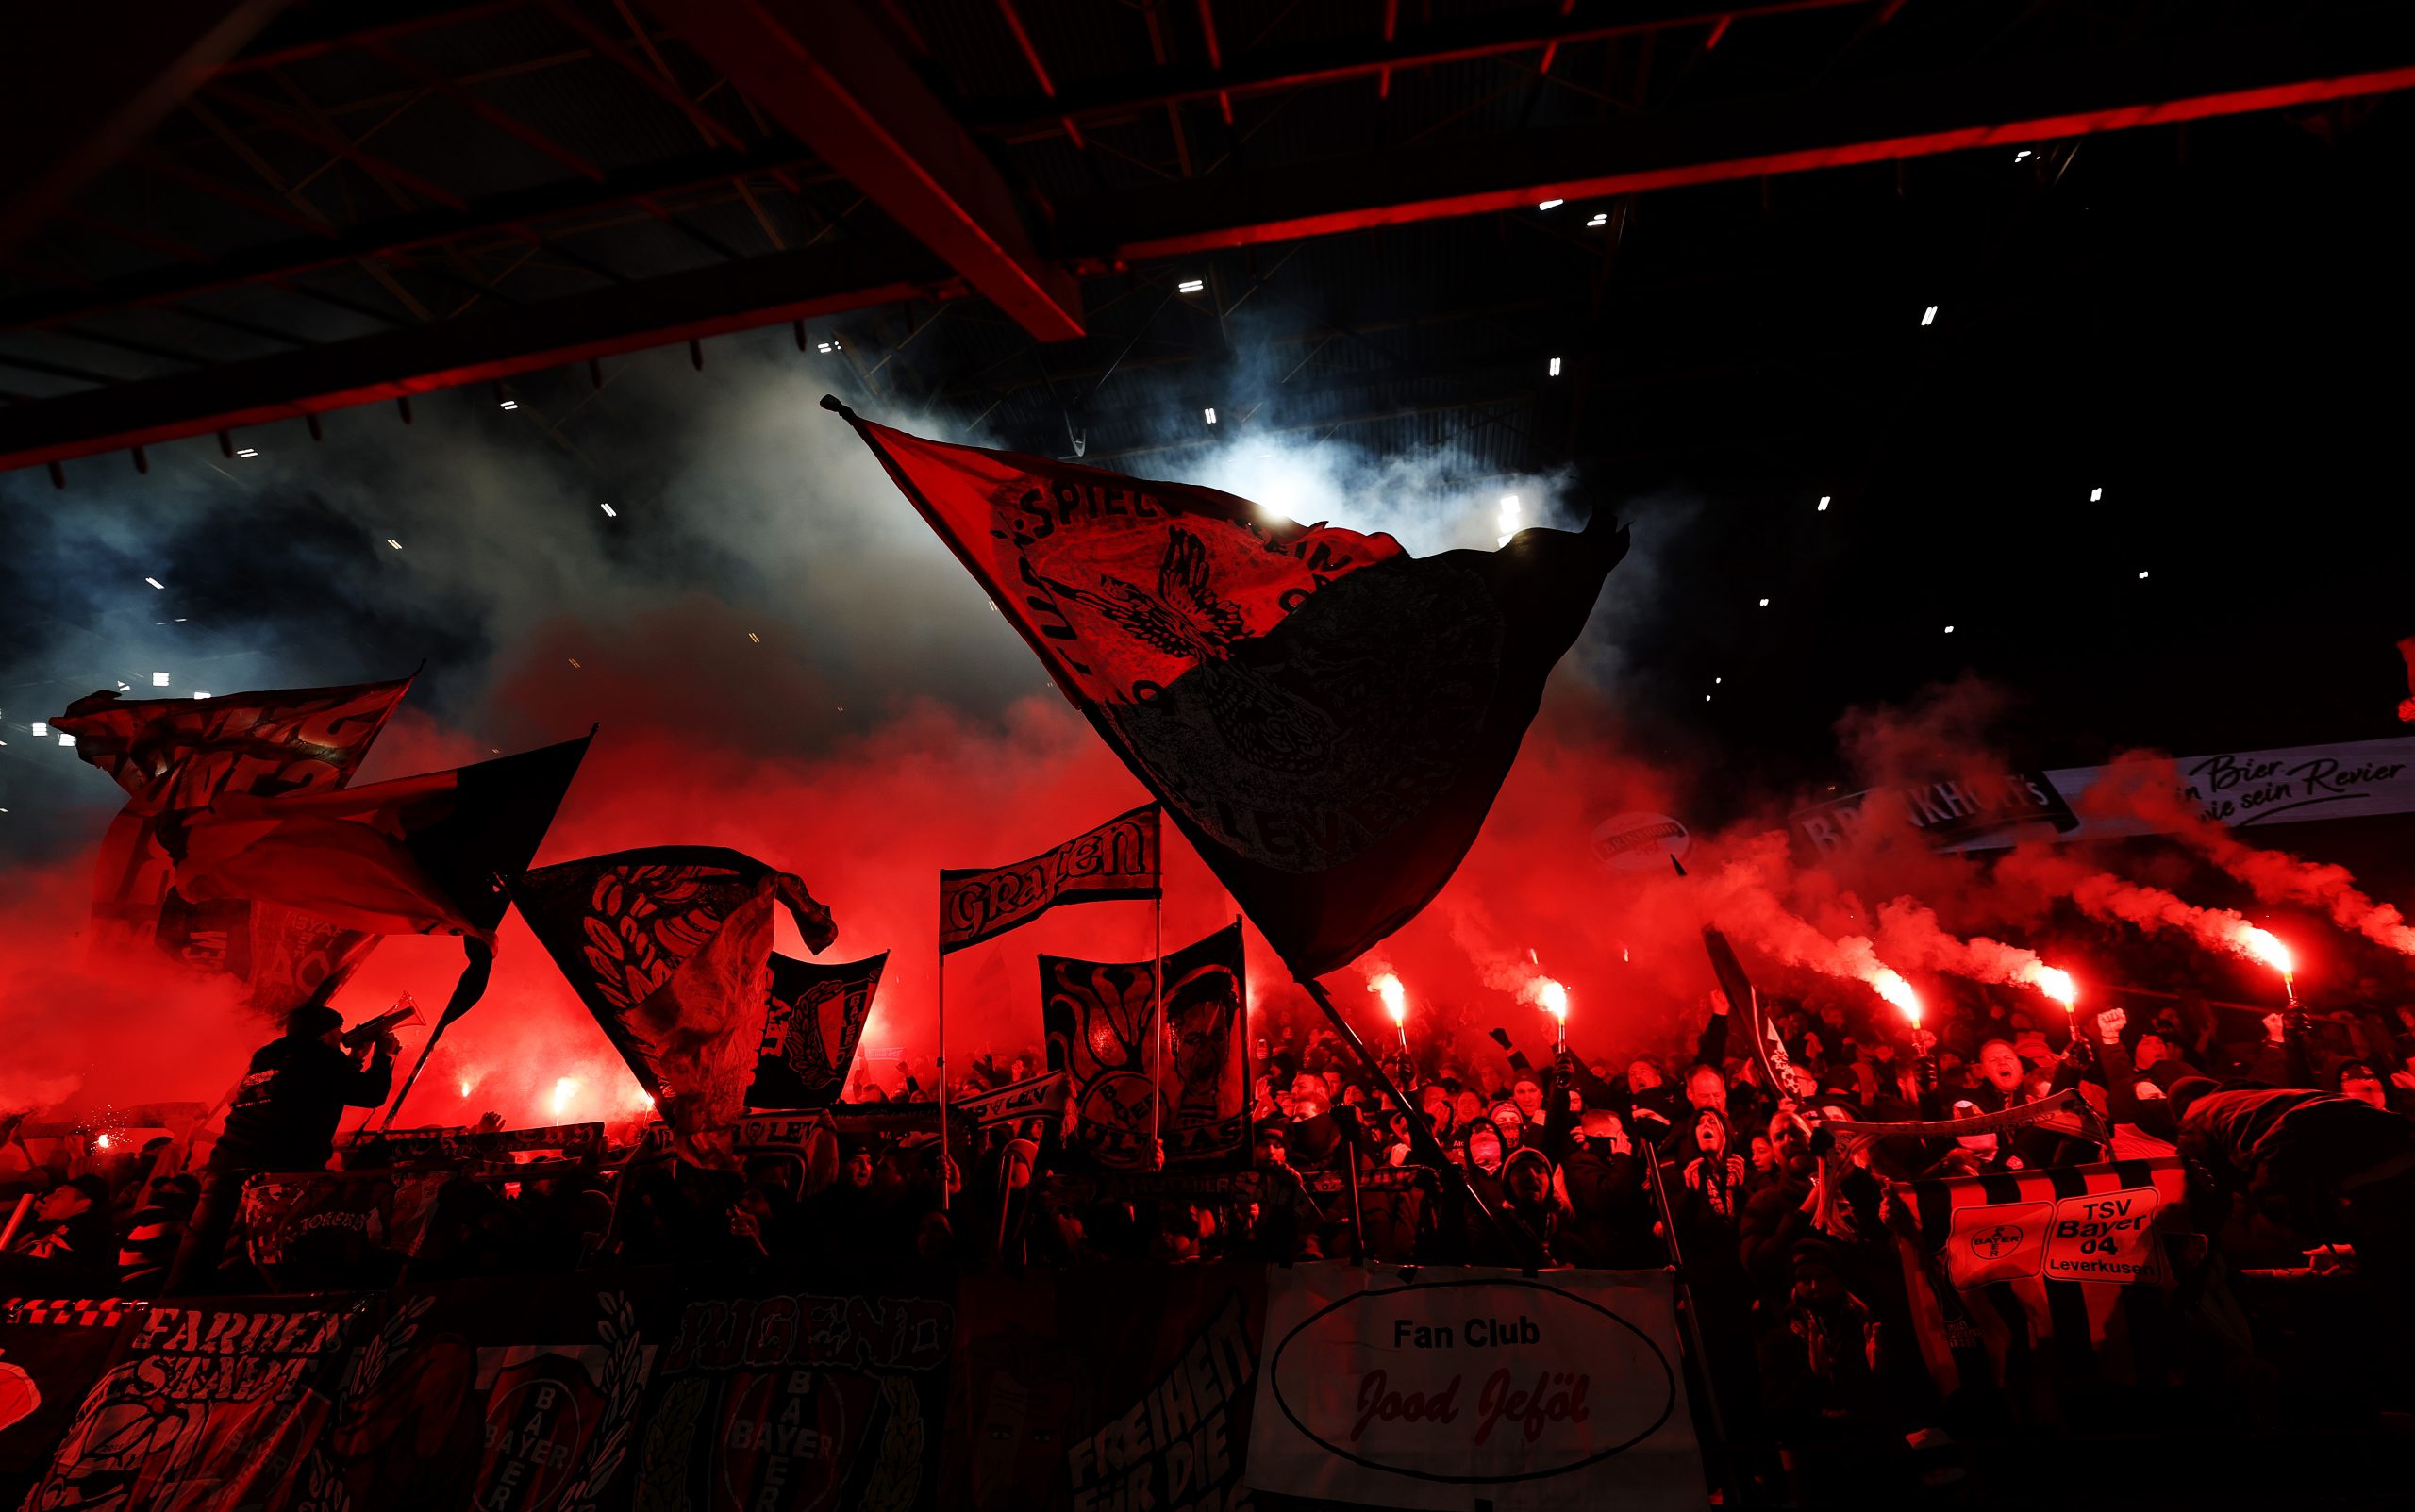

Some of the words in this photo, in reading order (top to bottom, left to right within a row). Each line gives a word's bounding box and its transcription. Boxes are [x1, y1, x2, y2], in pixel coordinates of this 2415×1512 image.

[2190, 755, 2283, 792] Bier
[2240, 782, 2292, 809] sein
[2285, 757, 2407, 796] Revier
[2056, 1213, 2147, 1240] Bayer
[2083, 1198, 2132, 1221] TSV
[1973, 1236, 2020, 1246] BAYER
[2080, 1236, 2119, 1255] 04
[2050, 1258, 2155, 1275] Leverkusen
[1393, 1318, 1454, 1349] Fan
[1464, 1315, 1541, 1347] Club
[1350, 1368, 1462, 1443] Jood
[1474, 1366, 1591, 1446] Jeföl
[484, 1423, 568, 1470] BAYER
[486, 1386, 558, 1511] BAYER
[729, 1418, 834, 1462] BAYER
